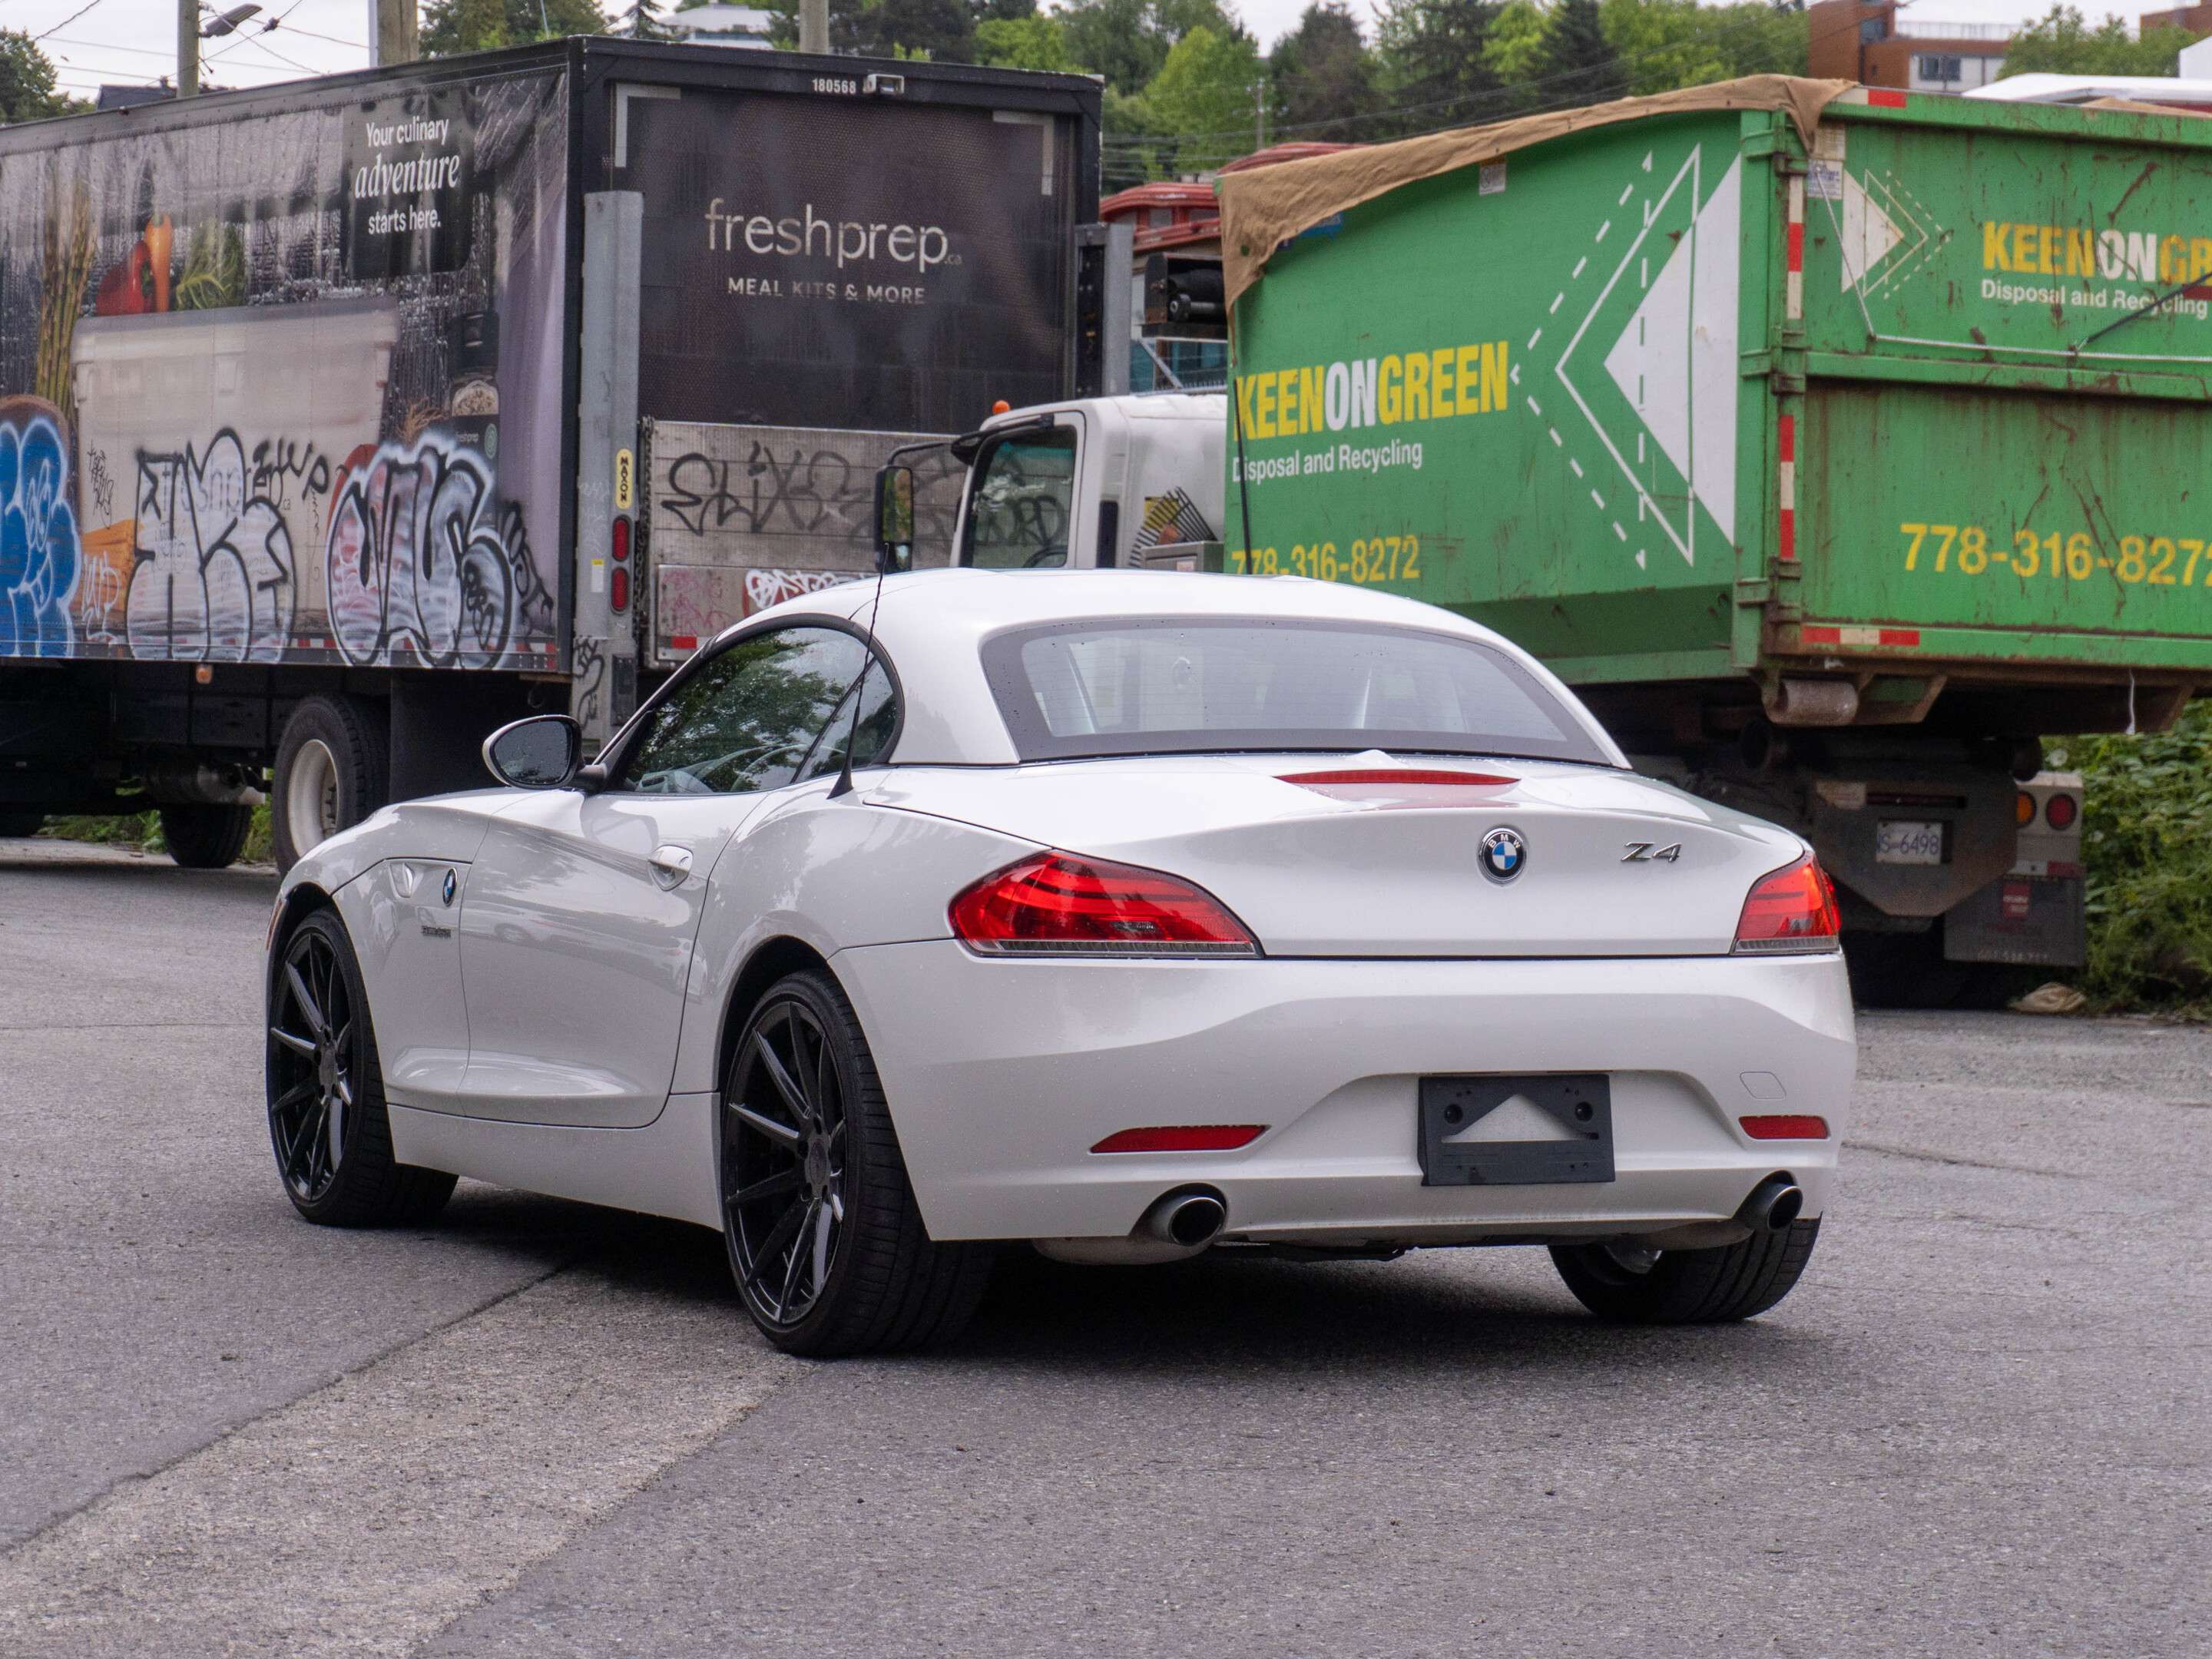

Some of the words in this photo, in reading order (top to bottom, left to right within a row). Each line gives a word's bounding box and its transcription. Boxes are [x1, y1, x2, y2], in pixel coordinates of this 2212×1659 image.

[812, 78, 857, 94] 180568
[366, 121, 394, 147] Your
[396, 115, 449, 146] culinary
[355, 151, 460, 198] adventure
[368, 208, 407, 235] starts
[409, 204, 442, 230] here.
[728, 276, 783, 297] MEAL
[792, 280, 837, 300] KITS
[844, 283, 859, 301] &
[866, 284, 926, 305] MORE
[1980, 278, 2067, 305] Disposal
[2071, 288, 2108, 307] and
[1233, 340, 1509, 442] KEENONGREEN
[1303, 446, 1335, 474] and
[1338, 437, 1422, 473] Recycling
[620, 456, 629, 502] MAXON
[1230, 535, 1419, 584] 778-316-8272
[1899, 522, 2212, 588] 778-316-827
[1621, 842, 1682, 863] Z4
